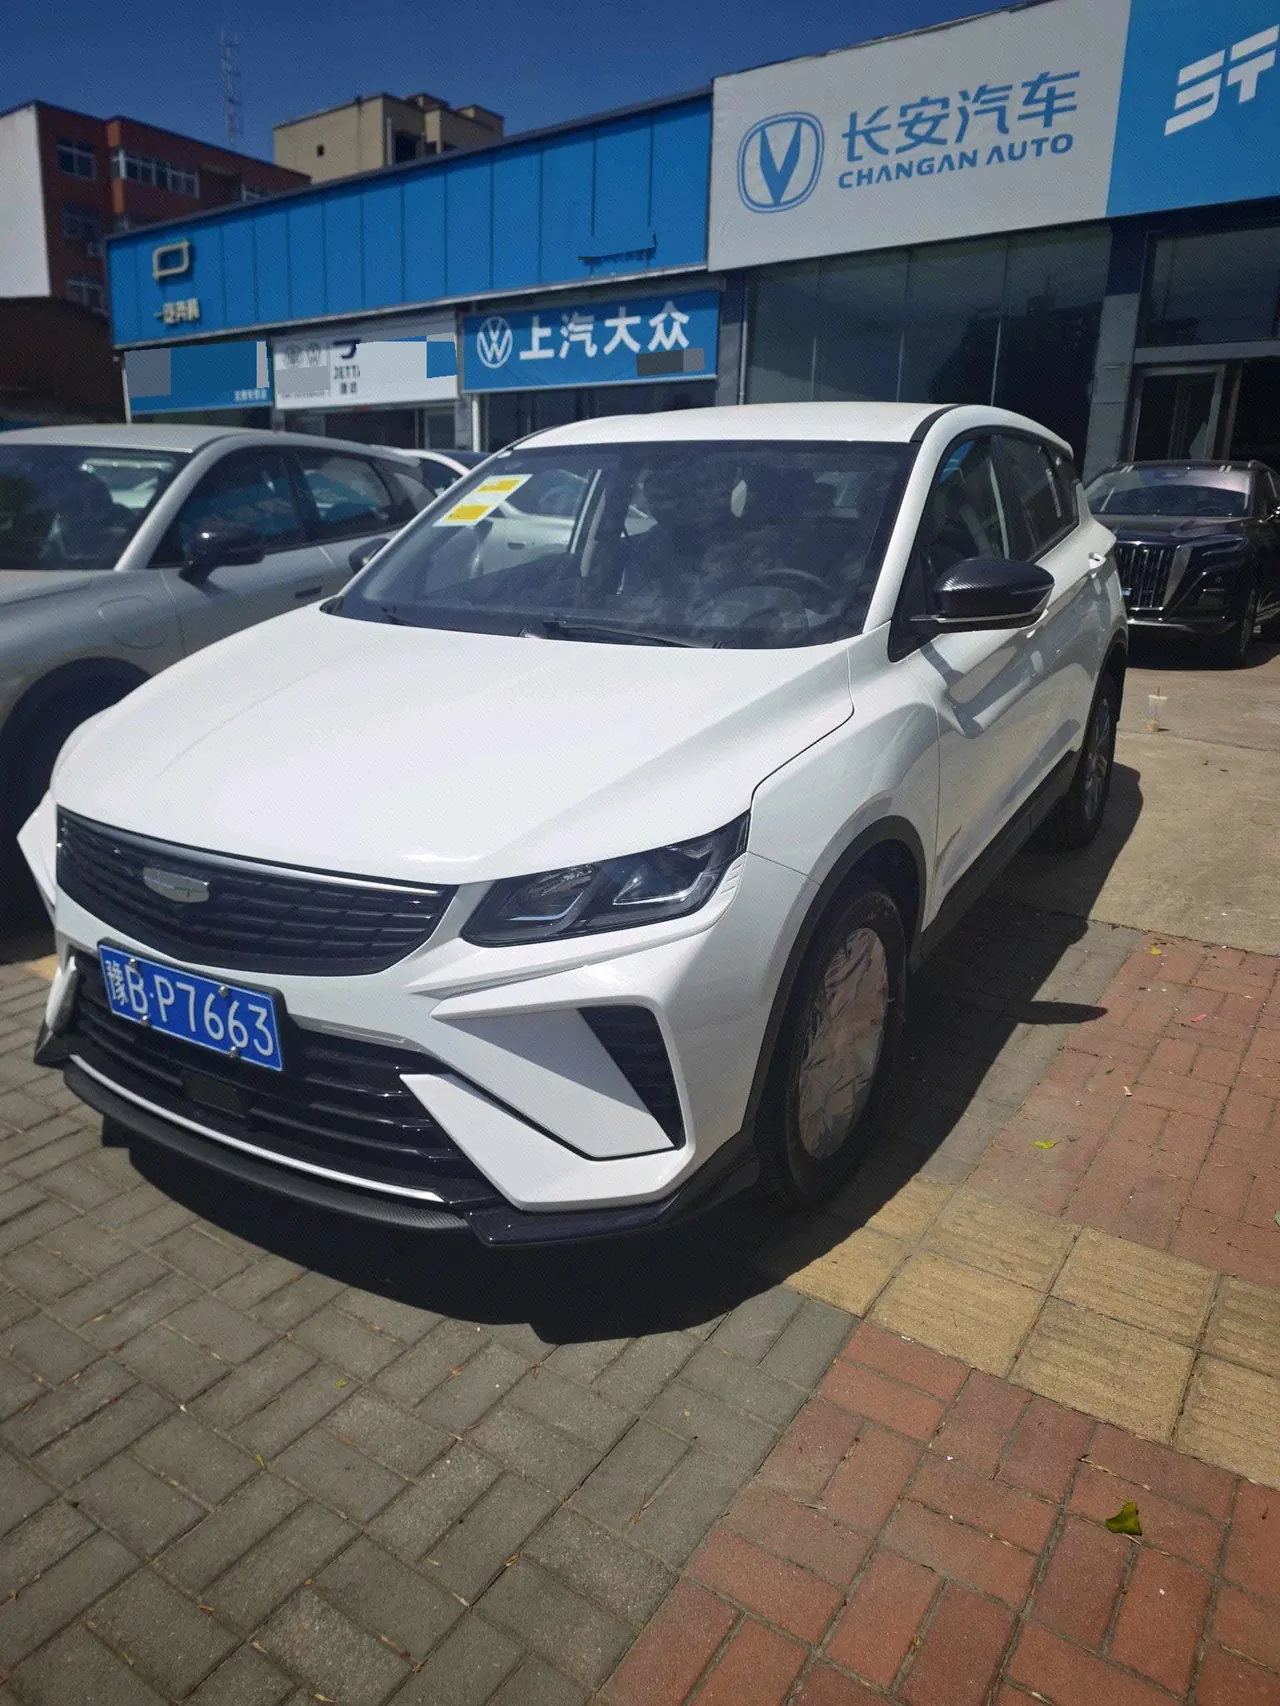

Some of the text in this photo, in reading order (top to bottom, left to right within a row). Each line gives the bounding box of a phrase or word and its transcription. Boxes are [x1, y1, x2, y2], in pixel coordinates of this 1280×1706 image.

[842, 71, 1080, 162] 长安汽车
[838, 133, 1074, 189] CHANGAN AUTO
[519, 301, 690, 361] 上汽大众
